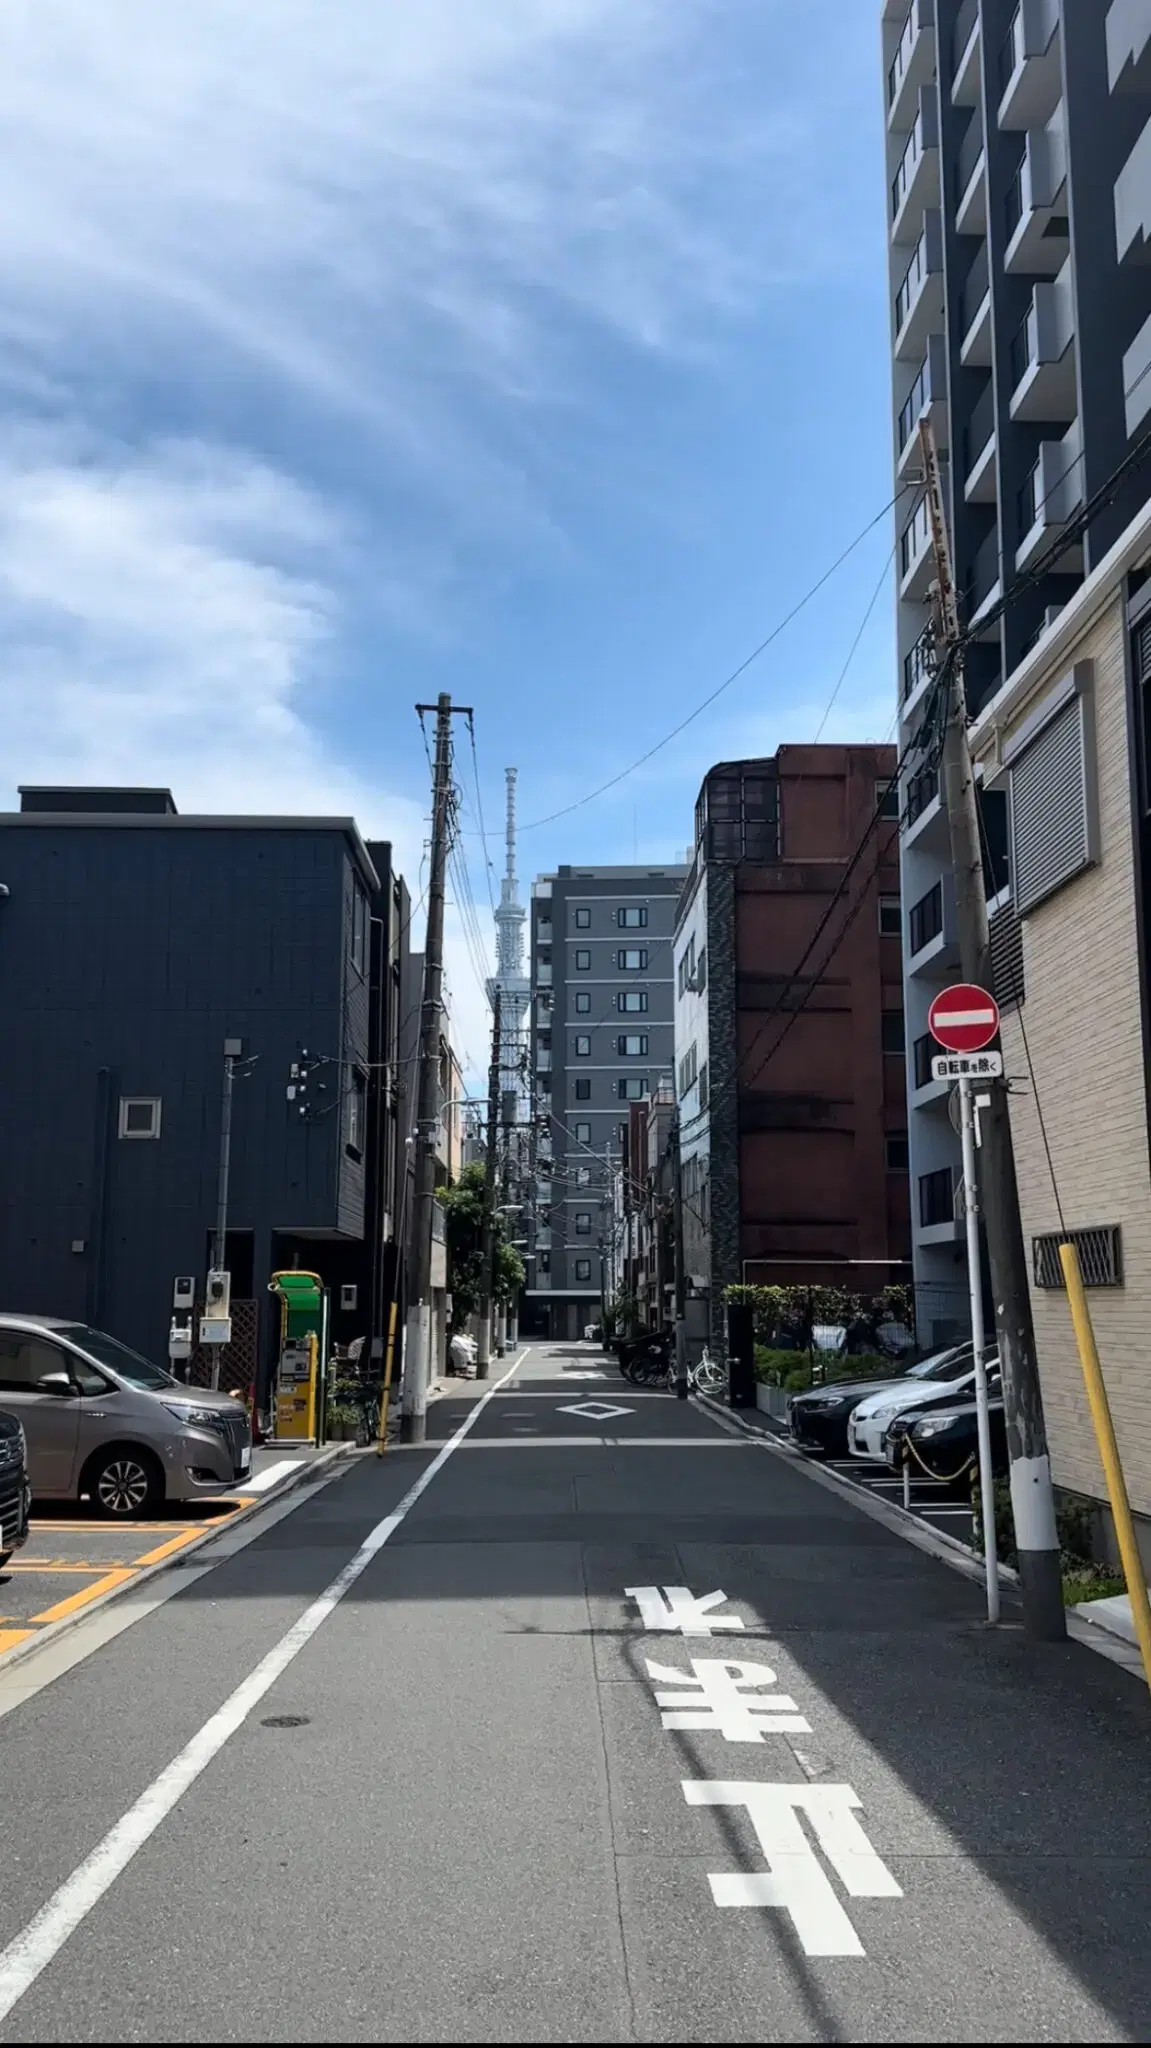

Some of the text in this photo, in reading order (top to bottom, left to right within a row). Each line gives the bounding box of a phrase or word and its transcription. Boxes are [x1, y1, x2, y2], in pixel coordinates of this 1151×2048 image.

[937, 1058, 997, 1076] 自転車を除く
[624, 1586, 904, 1956] 止まれ
